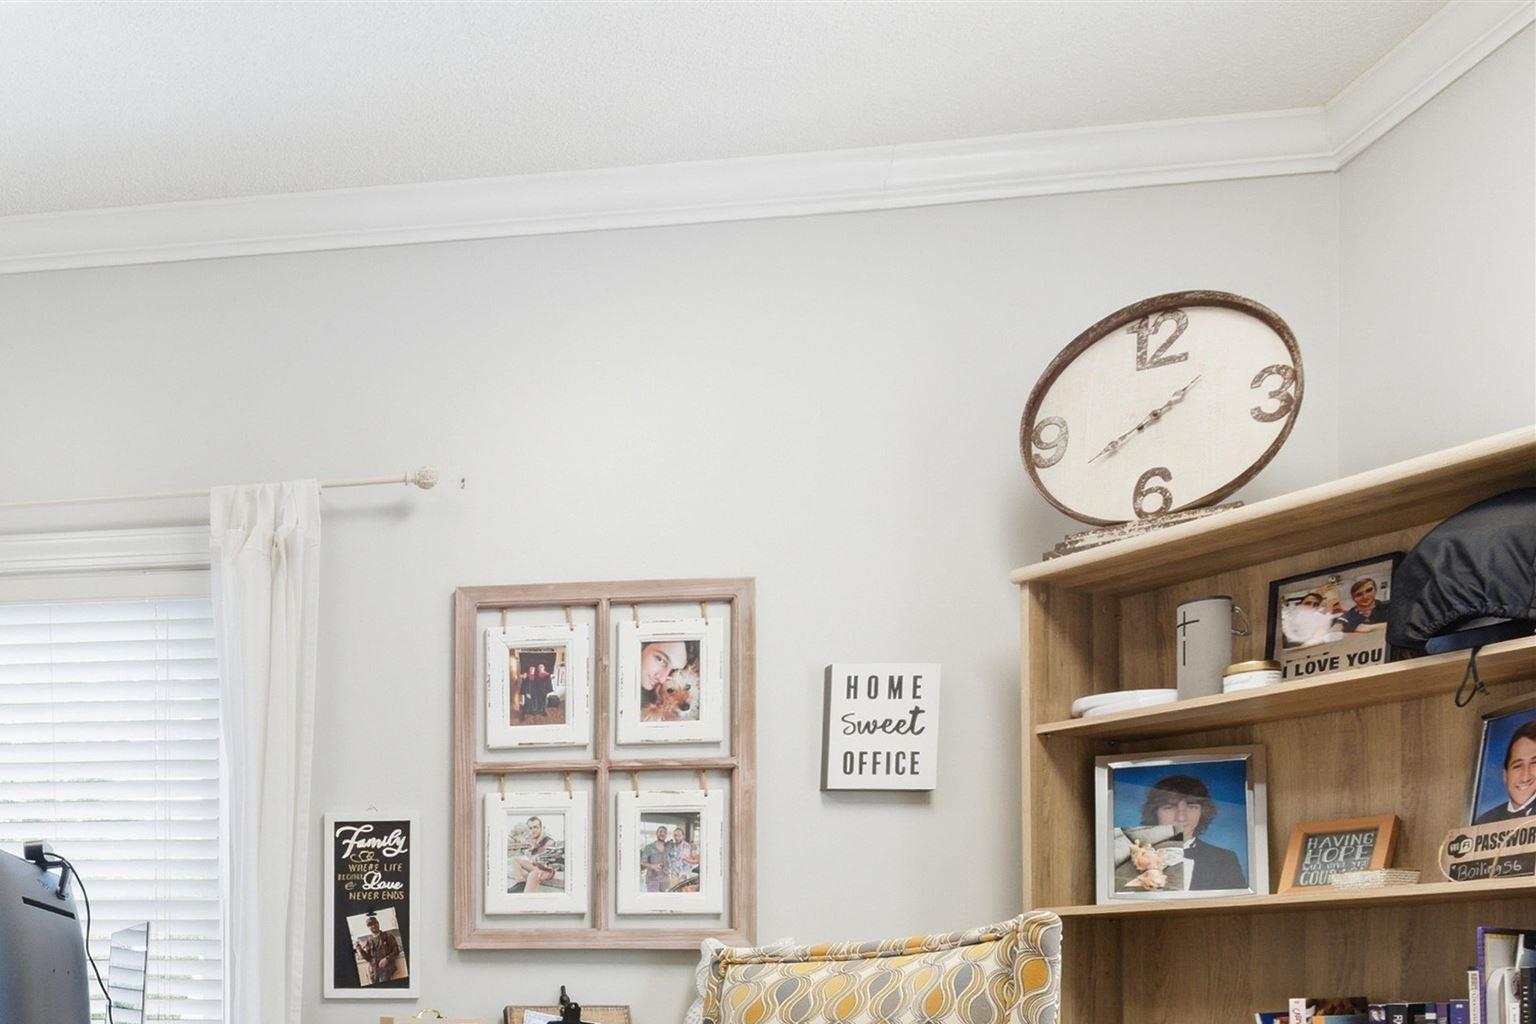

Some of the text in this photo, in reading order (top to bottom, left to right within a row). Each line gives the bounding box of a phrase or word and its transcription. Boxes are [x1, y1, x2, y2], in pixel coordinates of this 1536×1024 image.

[1126, 309, 1189, 372] 12
[1249, 364, 1297, 423] 3
[1031, 416, 1069, 469] 9
[1132, 466, 1173, 520] 6
[1294, 655, 1340, 677] LOVE
[1346, 647, 1383, 668] YOU
[845, 674, 924, 700] HOME
[840, 704, 926, 736] Sweet
[842, 750, 921, 776] OFFICE
[335, 824, 408, 859] Family
[1307, 832, 1375, 849] HAVING
[1474, 826, 1536, 852] PASSWOR
[1304, 844, 1373, 865] HOPE
[362, 870, 404, 890] Love
[348, 890, 405, 900] NEVER ENDS
